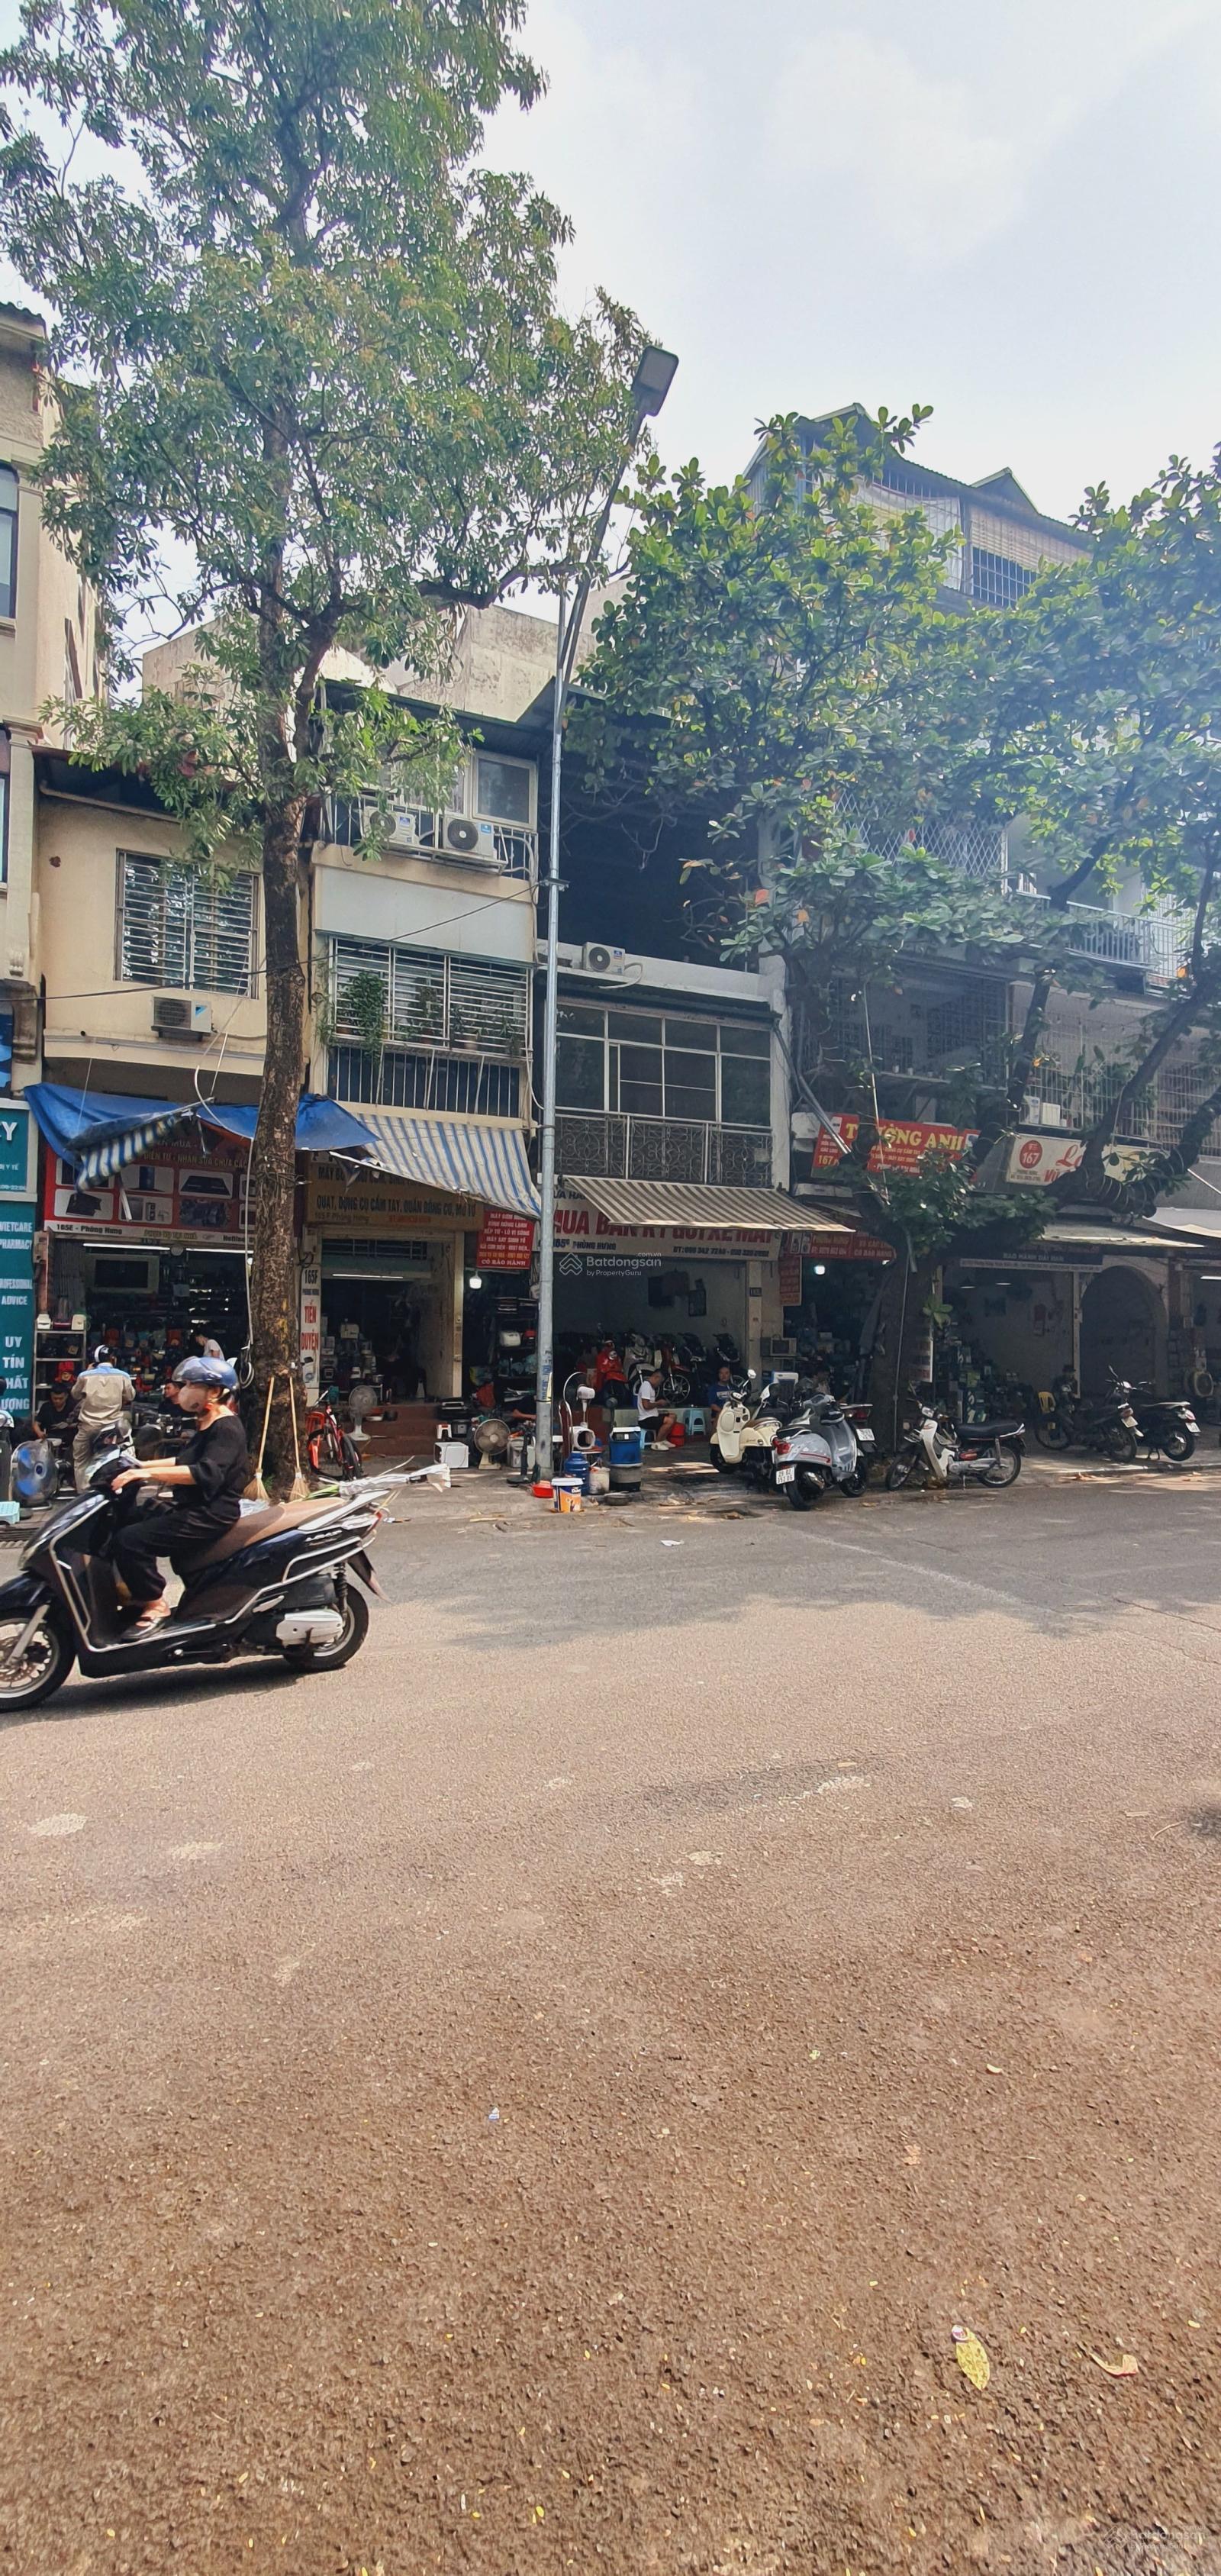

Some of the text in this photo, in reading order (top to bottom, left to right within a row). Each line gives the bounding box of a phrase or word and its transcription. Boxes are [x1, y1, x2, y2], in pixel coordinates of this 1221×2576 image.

[1023, 1153, 1039, 1165] 167
[2, 1295, 27, 1306] ADVICE
[5, 1336, 23, 1348] UY
[2, 1354, 25, 1369] TÍN
[5, 1374, 29, 1389] HẤT
[2, 1398, 30, 1413] ƯỢNG
